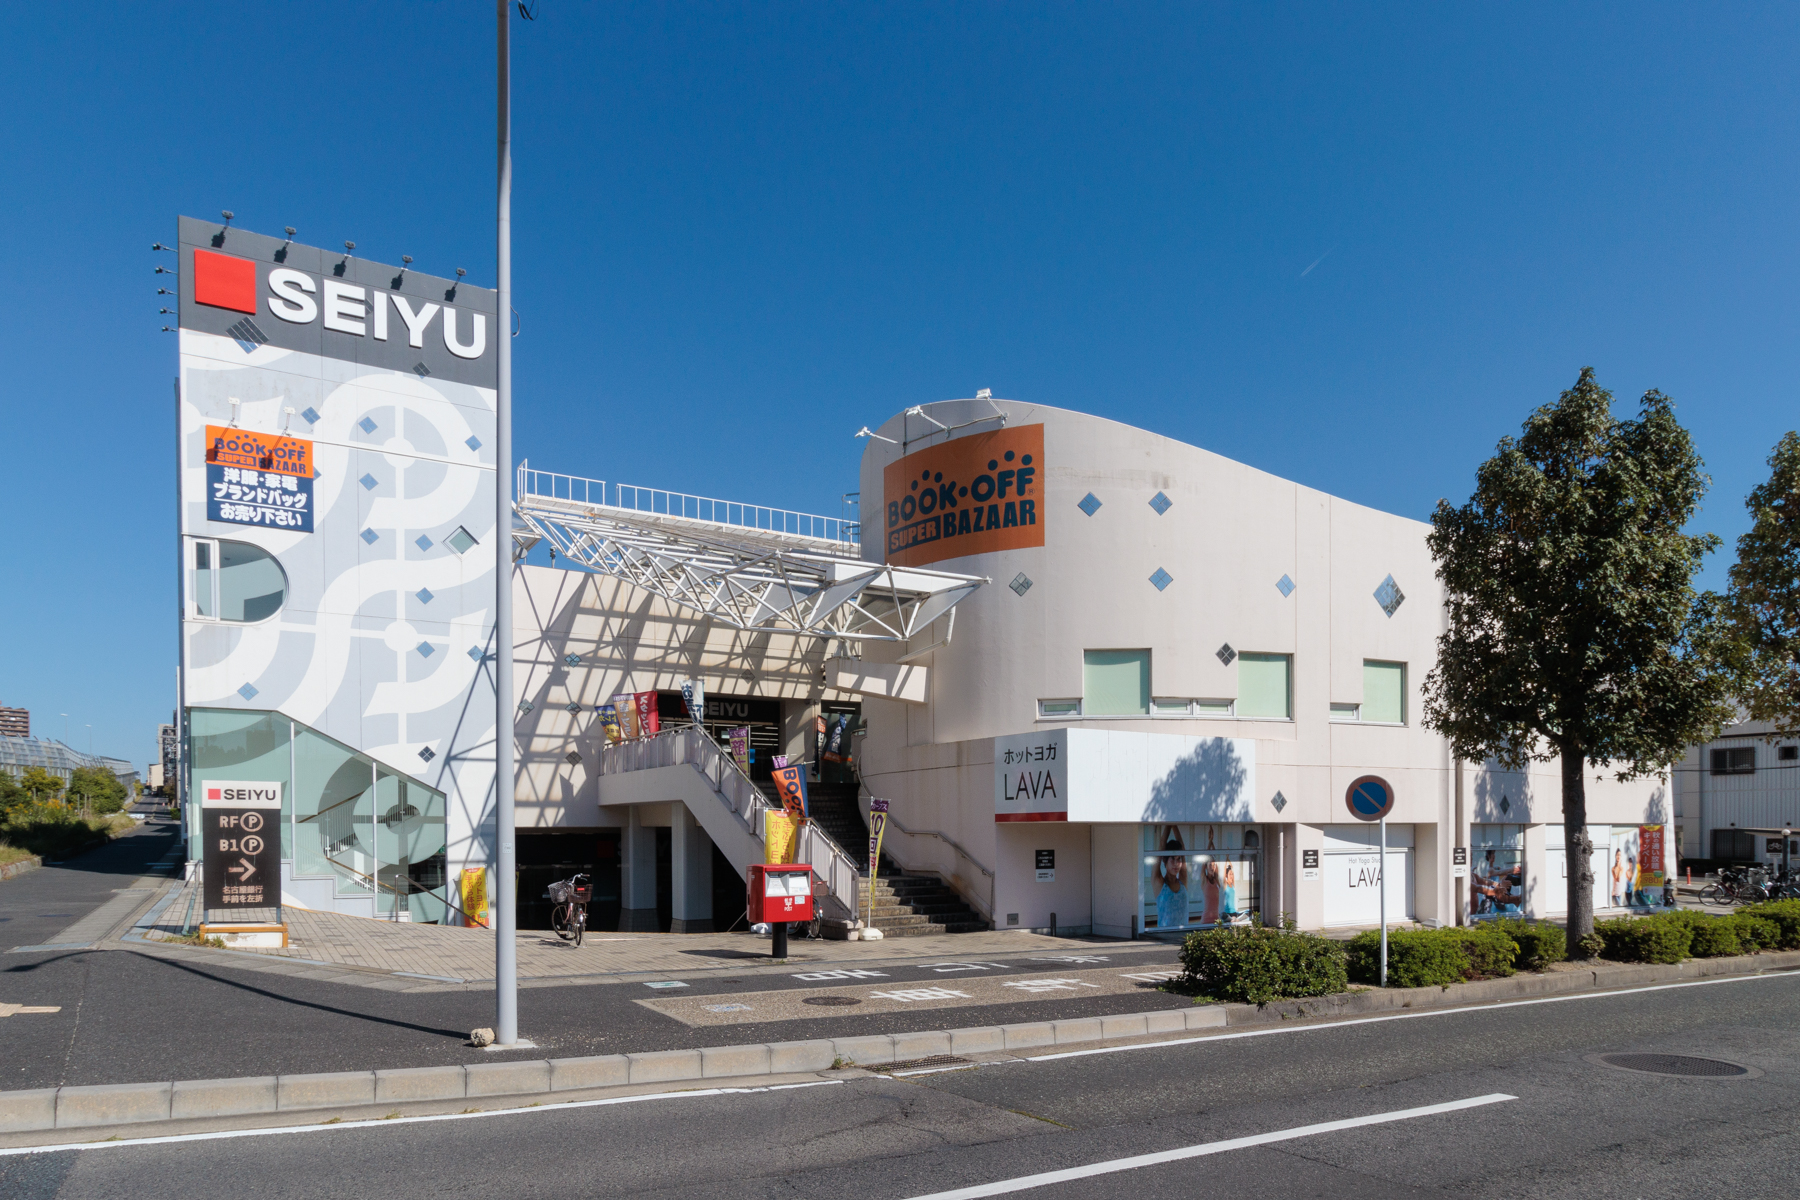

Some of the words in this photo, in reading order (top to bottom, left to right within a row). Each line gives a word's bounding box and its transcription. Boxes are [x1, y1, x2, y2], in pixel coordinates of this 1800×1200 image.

[268, 269, 486, 359] SEIYU
[217, 452, 254, 465] SUPER
[259, 457, 306, 474] BAZAAR
[223, 467, 298, 491] 洋服・家電
[213, 482, 307, 508] ブランドバッグ
[220, 503, 302, 526] お売り下さい
[890, 521, 937, 550] SUPER
[943, 499, 1036, 538] BAZAAR
[1004, 742, 1058, 765] ホットヨガ
[223, 788, 276, 801] SEIYU
[1004, 769, 1057, 800] LAVA
[219, 815, 239, 828] RF
[219, 839, 239, 851] B1
[1642, 832, 1650, 870] キャンペーン
[1358, 857, 1370, 865] Yoga
[222, 885, 263, 894] 名古屋銀行
[222, 895, 263, 903] 手前を左折
[474, 874, 484, 909] ホットヨガ
